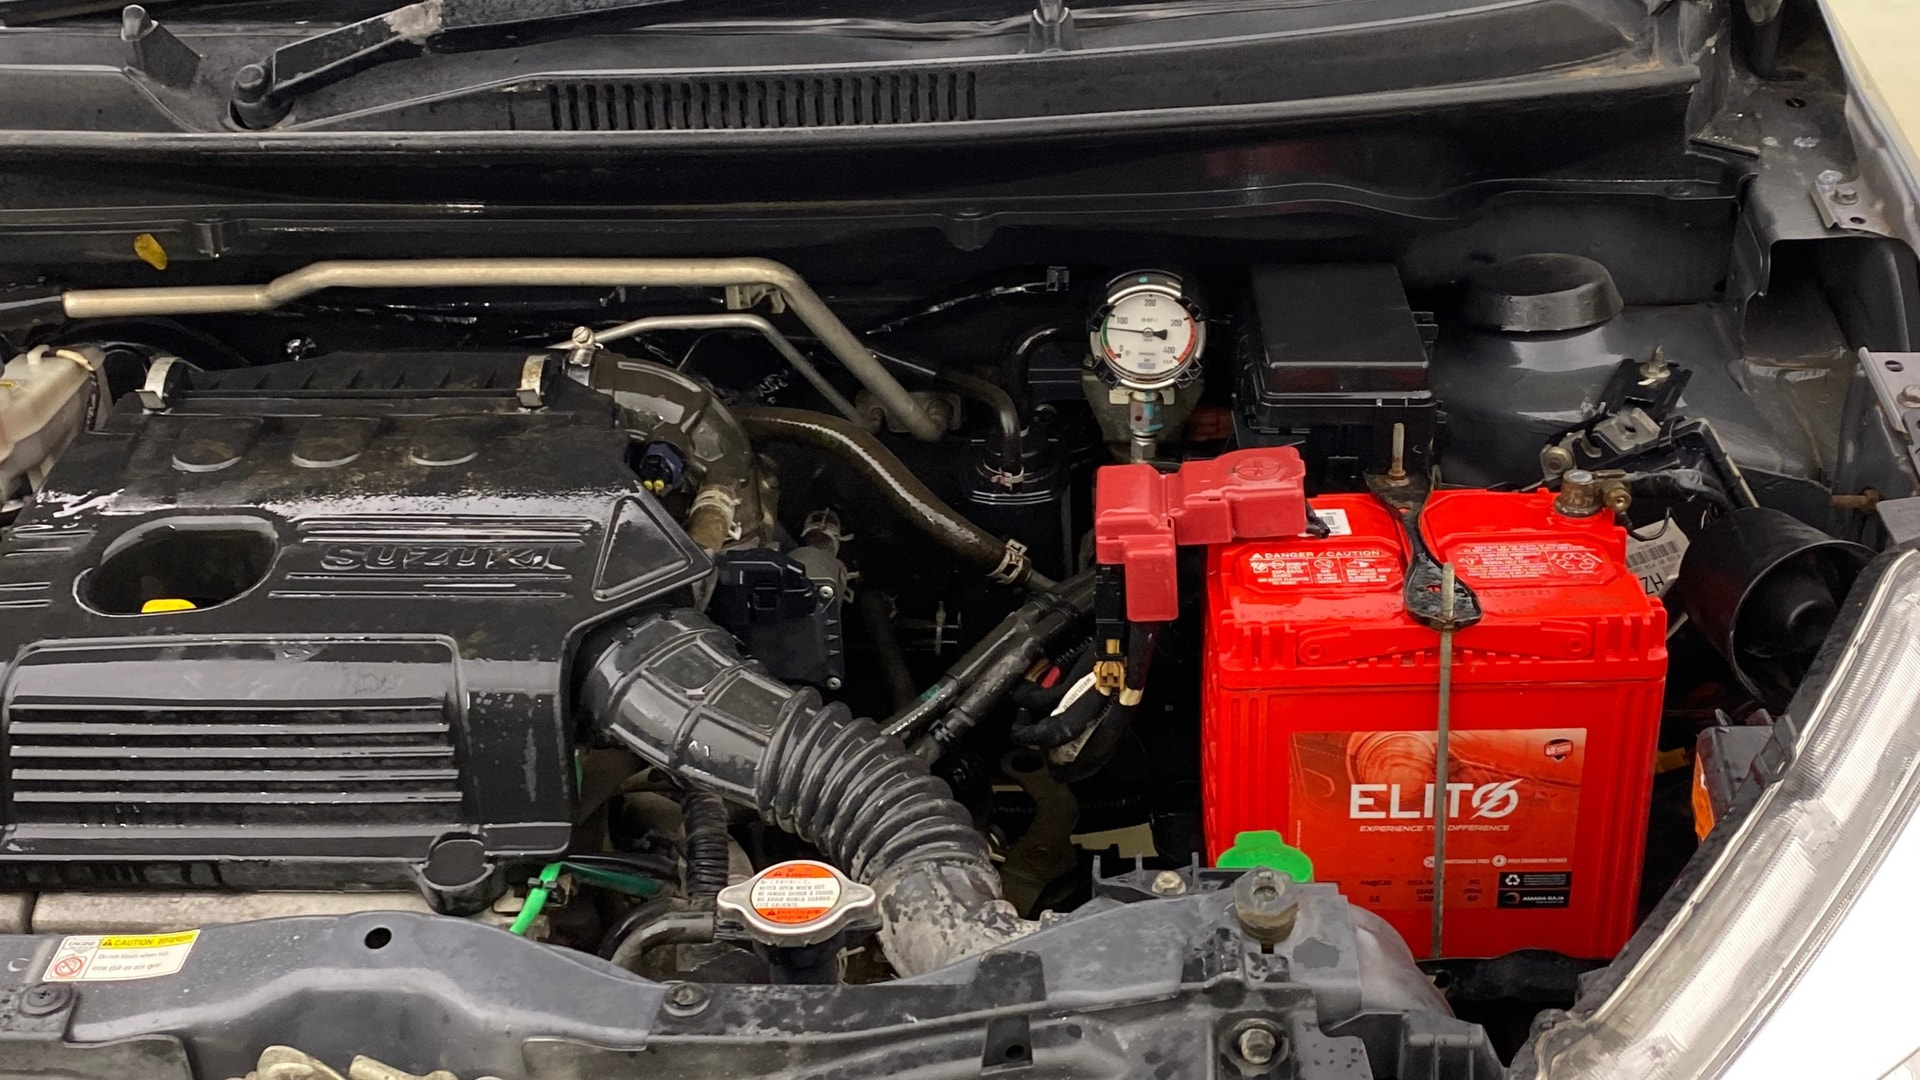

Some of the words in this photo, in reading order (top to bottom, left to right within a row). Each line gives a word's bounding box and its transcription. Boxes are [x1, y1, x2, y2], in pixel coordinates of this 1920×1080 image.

[1144, 299, 1156, 307] 200
[1163, 346, 1175, 354] 400
[320, 544, 566, 571] SUZUKI
[1263, 551, 1314, 559] DANGER
[1326, 550, 1380, 558] CAUTION
[1350, 778, 1523, 820] ELITO
[1447, 824, 1510, 832] DIFFERENCE
